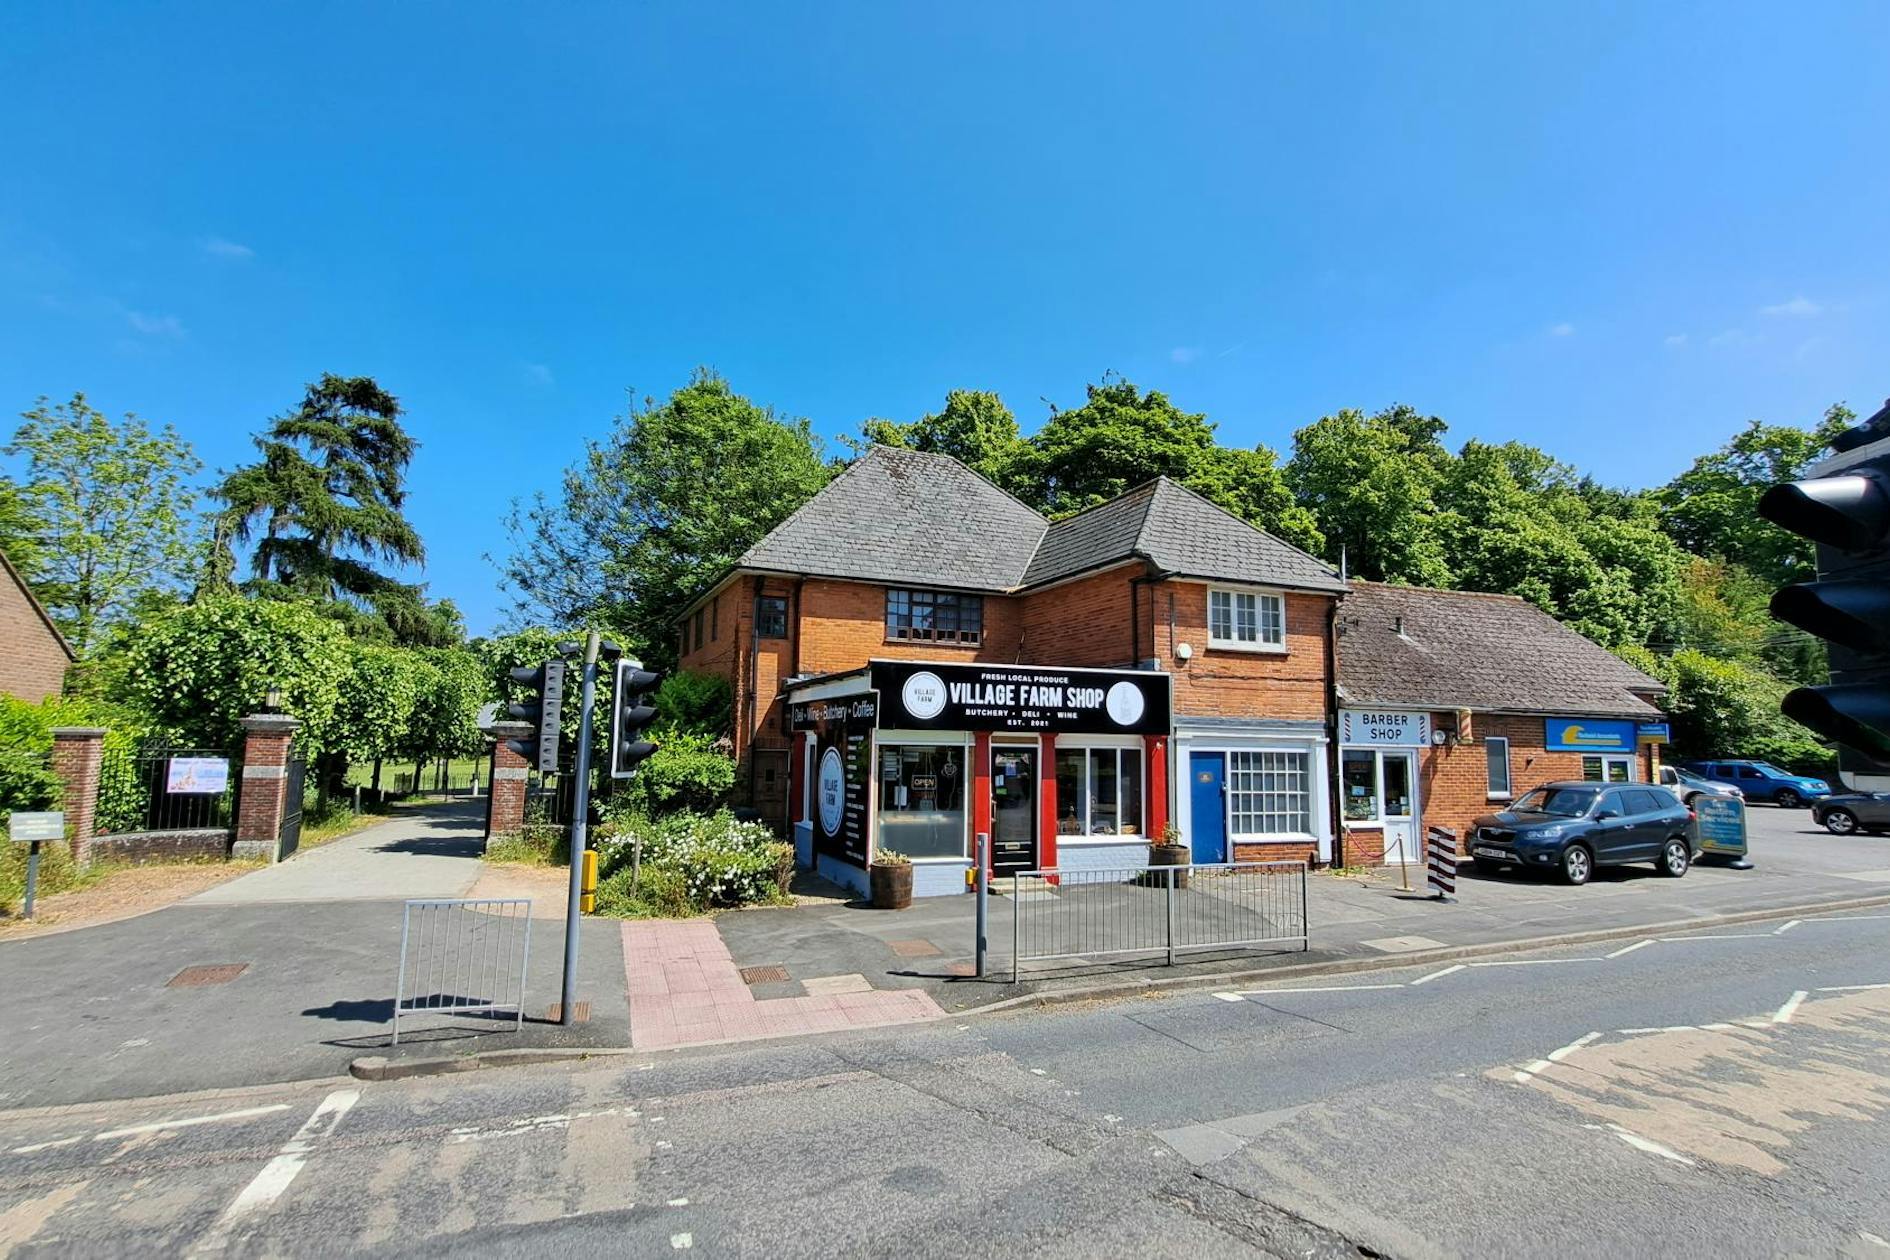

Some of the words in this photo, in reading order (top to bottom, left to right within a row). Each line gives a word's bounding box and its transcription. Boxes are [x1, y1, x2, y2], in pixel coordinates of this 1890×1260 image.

[981, 673, 1006, 681] FRESH
[1008, 674, 1032, 682] LOCAL
[1034, 675, 1068, 684] PRODUCE
[950, 682, 1015, 706] VILLAGE
[1020, 685, 1062, 708] FARM
[1066, 687, 1104, 708] SHOP
[807, 706, 820, 721] Wine
[823, 704, 847, 723] Butchery
[852, 700, 874, 718] Coffee
[965, 708, 1009, 716] BUTCHERY
[1022, 710, 1040, 718] DELI
[1057, 711, 1078, 719] WINE
[1362, 714, 1408, 726] BARBER
[1370, 728, 1402, 740] SHOP
[824, 779, 838, 792] VILLAGE
